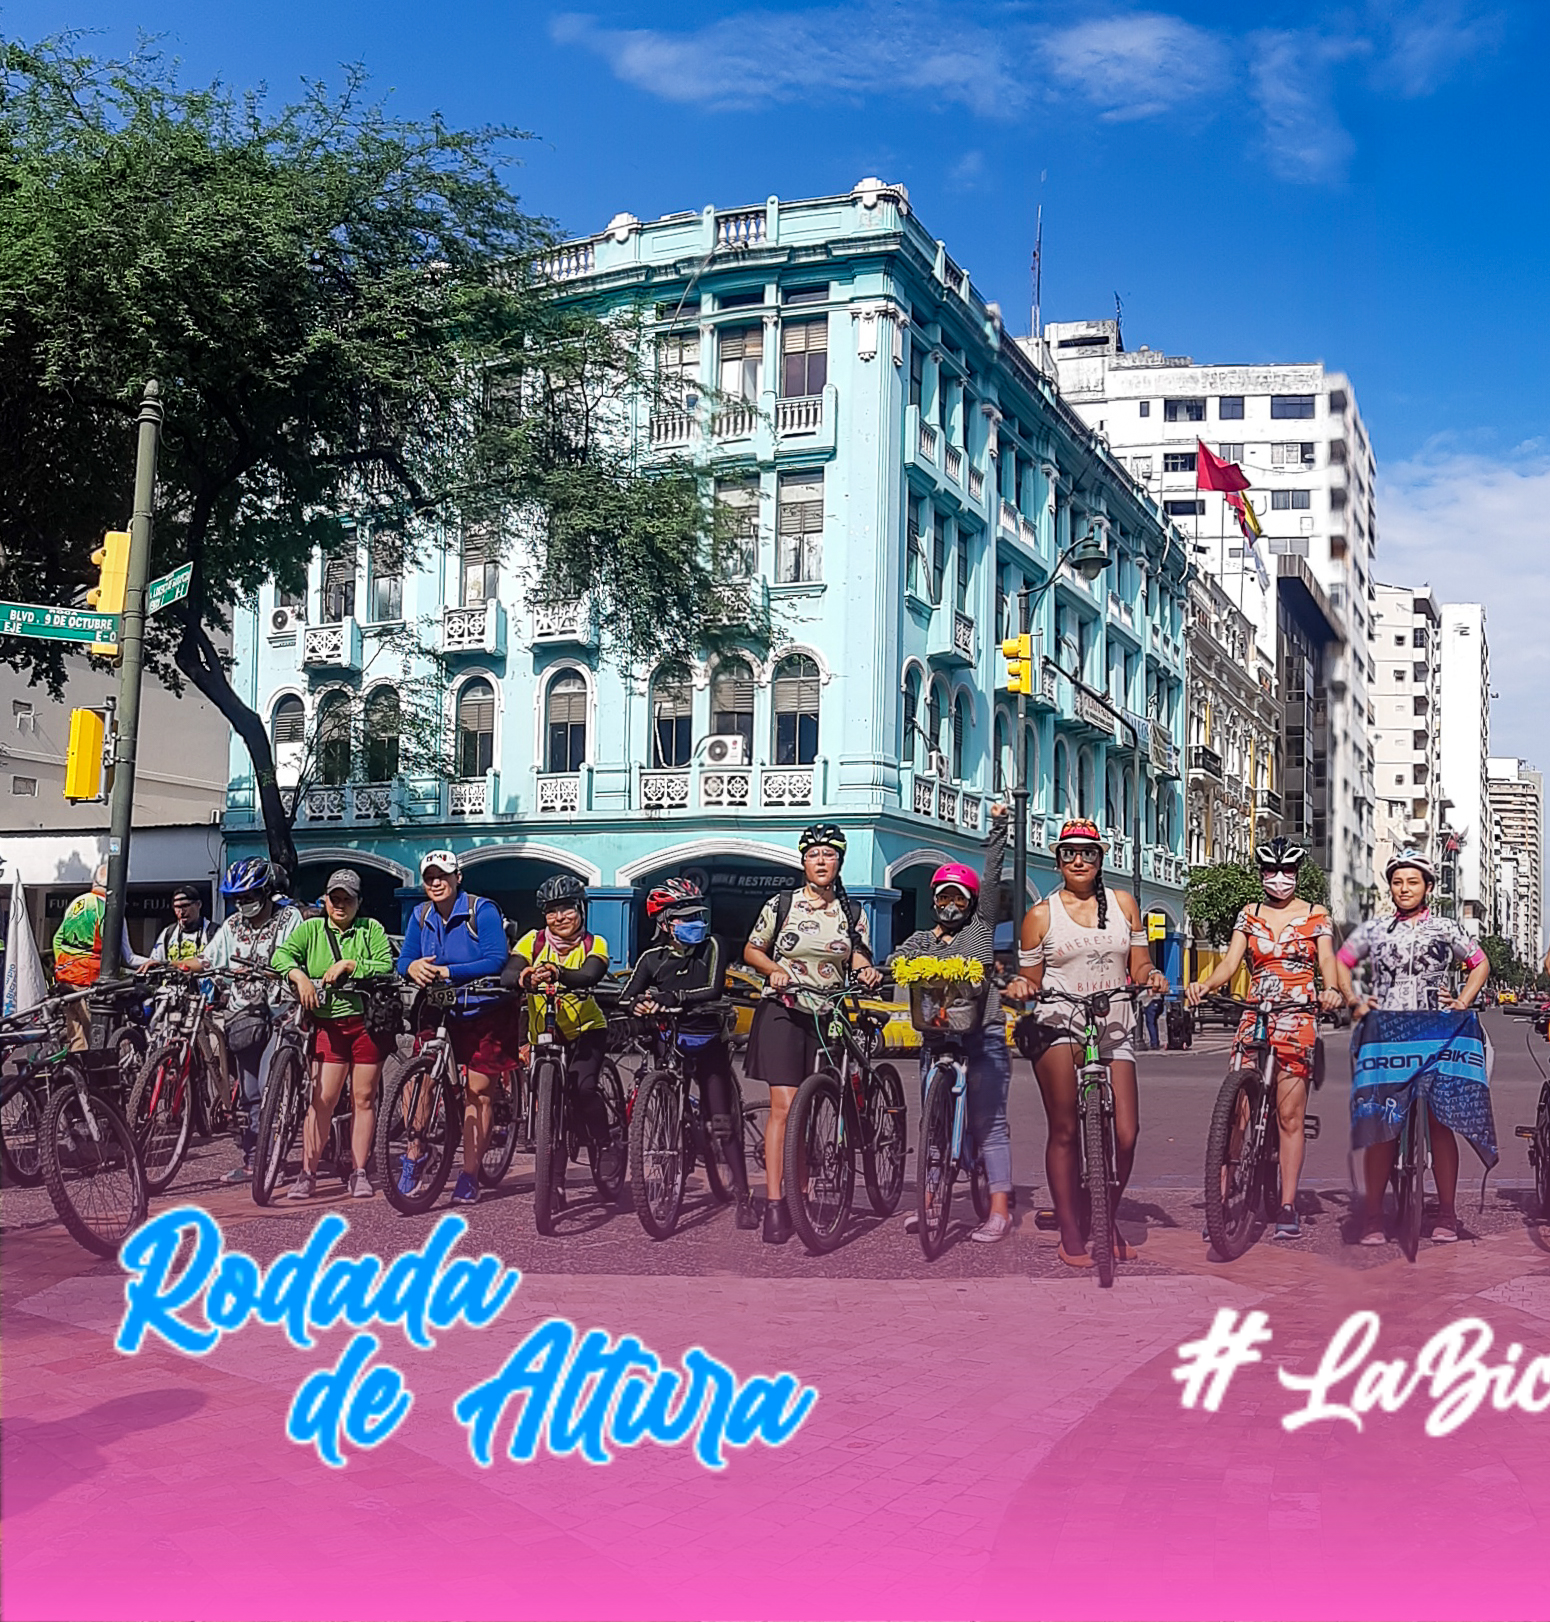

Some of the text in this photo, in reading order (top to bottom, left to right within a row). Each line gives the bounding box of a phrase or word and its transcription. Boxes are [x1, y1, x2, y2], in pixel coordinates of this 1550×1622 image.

[4, 621, 22, 633] EJE
[44, 614, 51, 625] 9
[53, 615, 67, 626] DE
[68, 616, 113, 630] OCTUBRE
[738, 876, 795, 887] RESTREPO
[1056, 936, 1113, 957] WHERE'S
